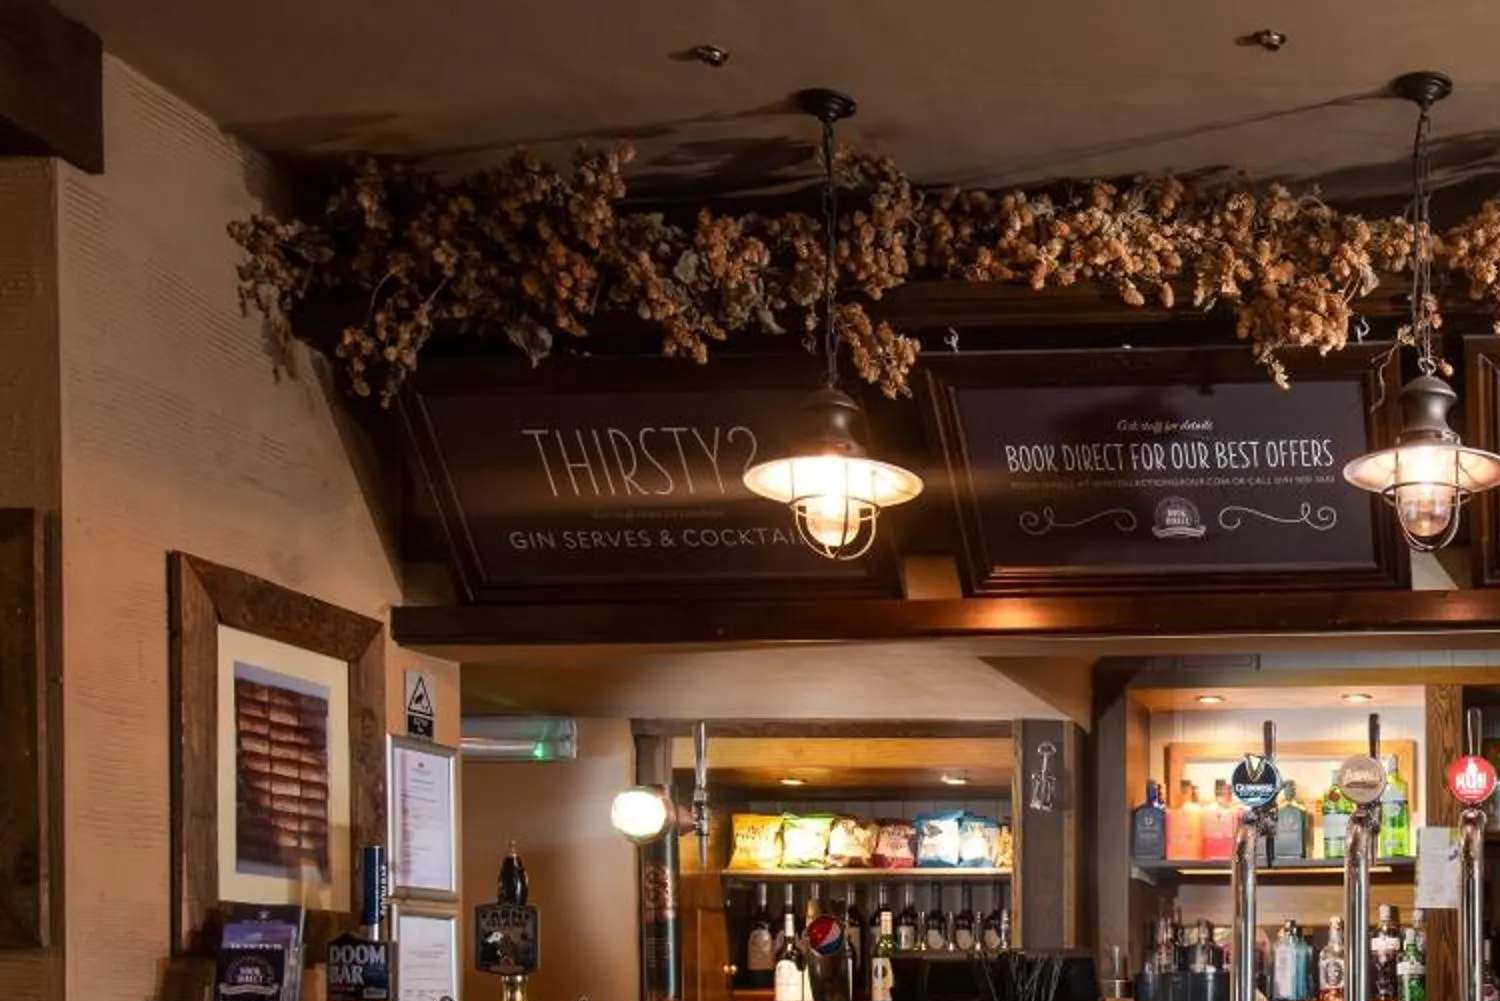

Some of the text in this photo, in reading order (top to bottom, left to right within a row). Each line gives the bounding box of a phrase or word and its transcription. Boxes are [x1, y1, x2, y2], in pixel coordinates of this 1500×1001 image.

[520, 426, 758, 497] THIRSTY?
[1004, 438, 1336, 473] BOOK DIRECT FOR OUR BEST OFFERS
[509, 526, 804, 550] GIN SERVES & COCKTAI
[329, 944, 386, 965] DOOM
[330, 965, 365, 985] BAR
